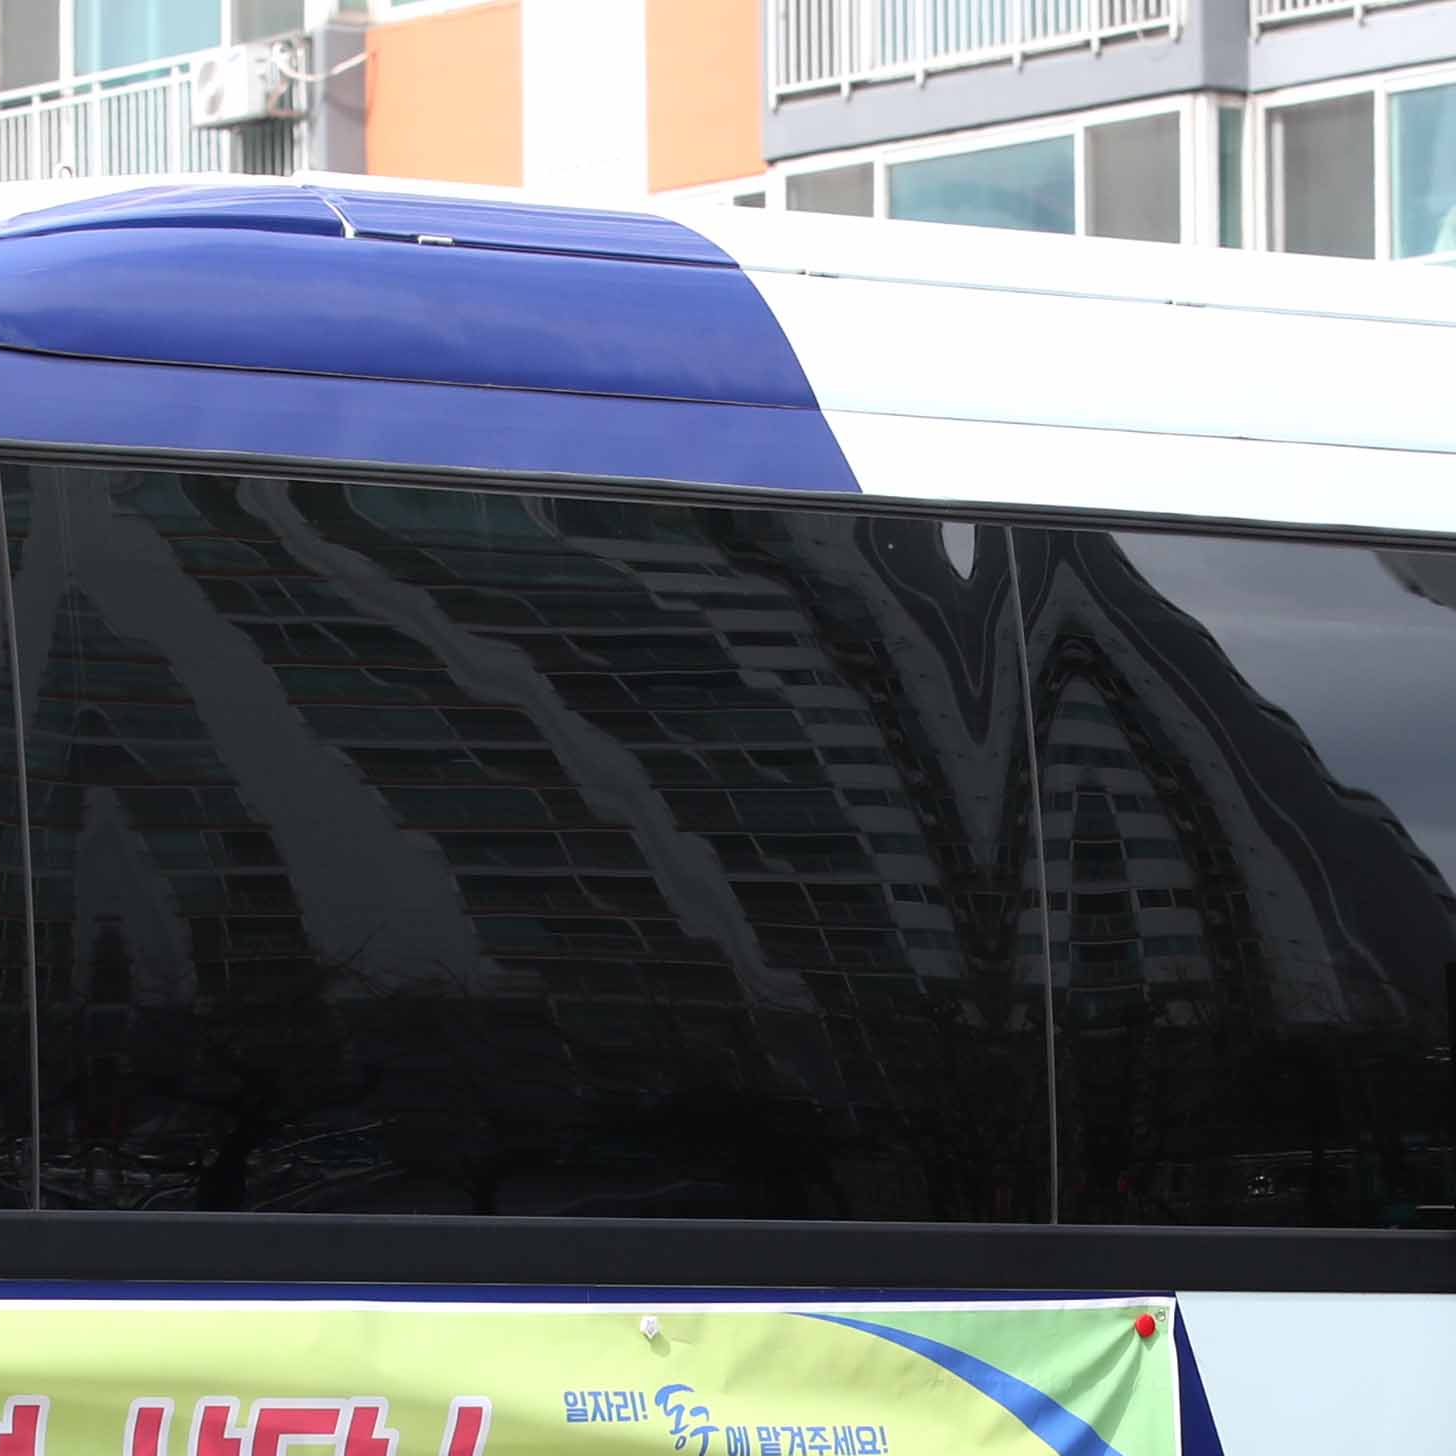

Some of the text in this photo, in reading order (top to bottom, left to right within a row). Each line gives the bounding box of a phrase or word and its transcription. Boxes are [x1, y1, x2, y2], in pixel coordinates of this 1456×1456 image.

[564, 1391, 648, 1424] 일자리!
[725, 1426, 752, 1456] 에
[756, 1425, 889, 1456] 맡겨주세요!
